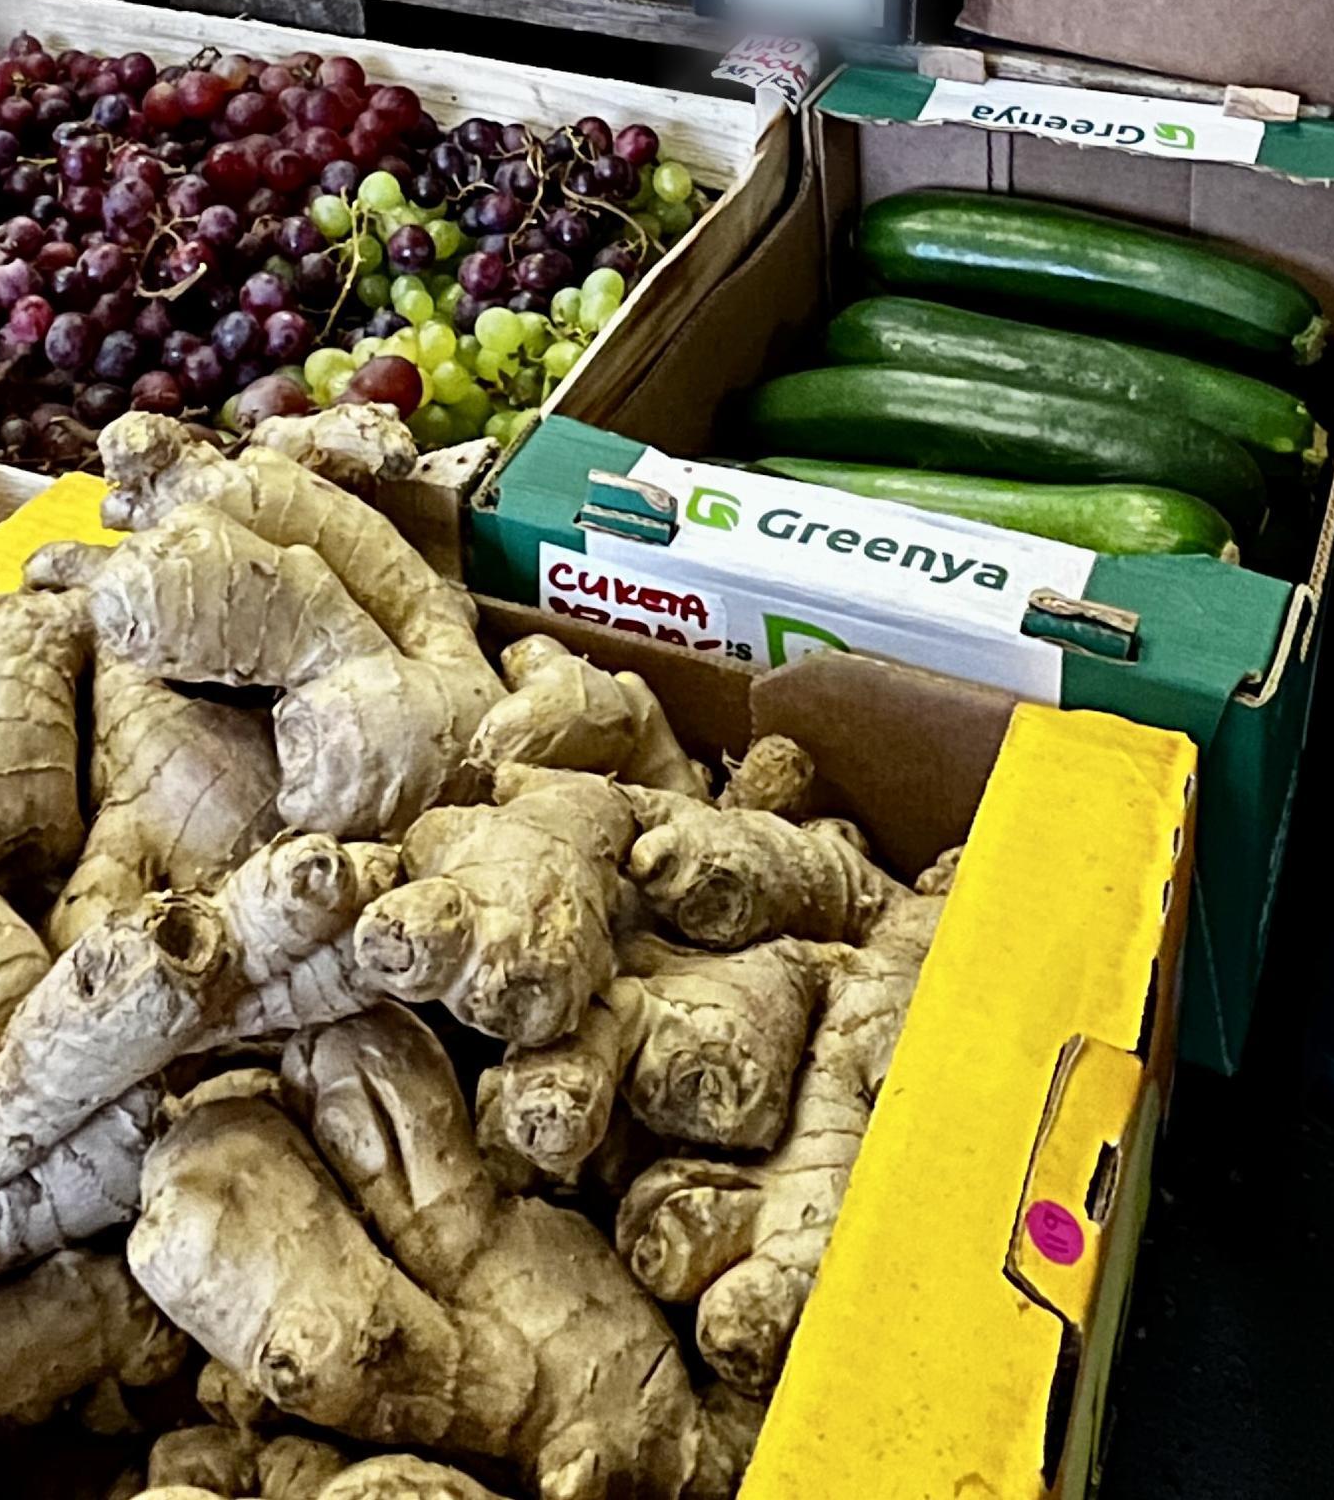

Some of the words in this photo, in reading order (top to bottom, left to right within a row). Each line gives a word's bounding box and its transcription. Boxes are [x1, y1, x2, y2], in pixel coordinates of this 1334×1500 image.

[970, 104, 1146, 146] Greenya
[756, 507, 1011, 593] Greenya
[547, 561, 710, 630] CUKETA
